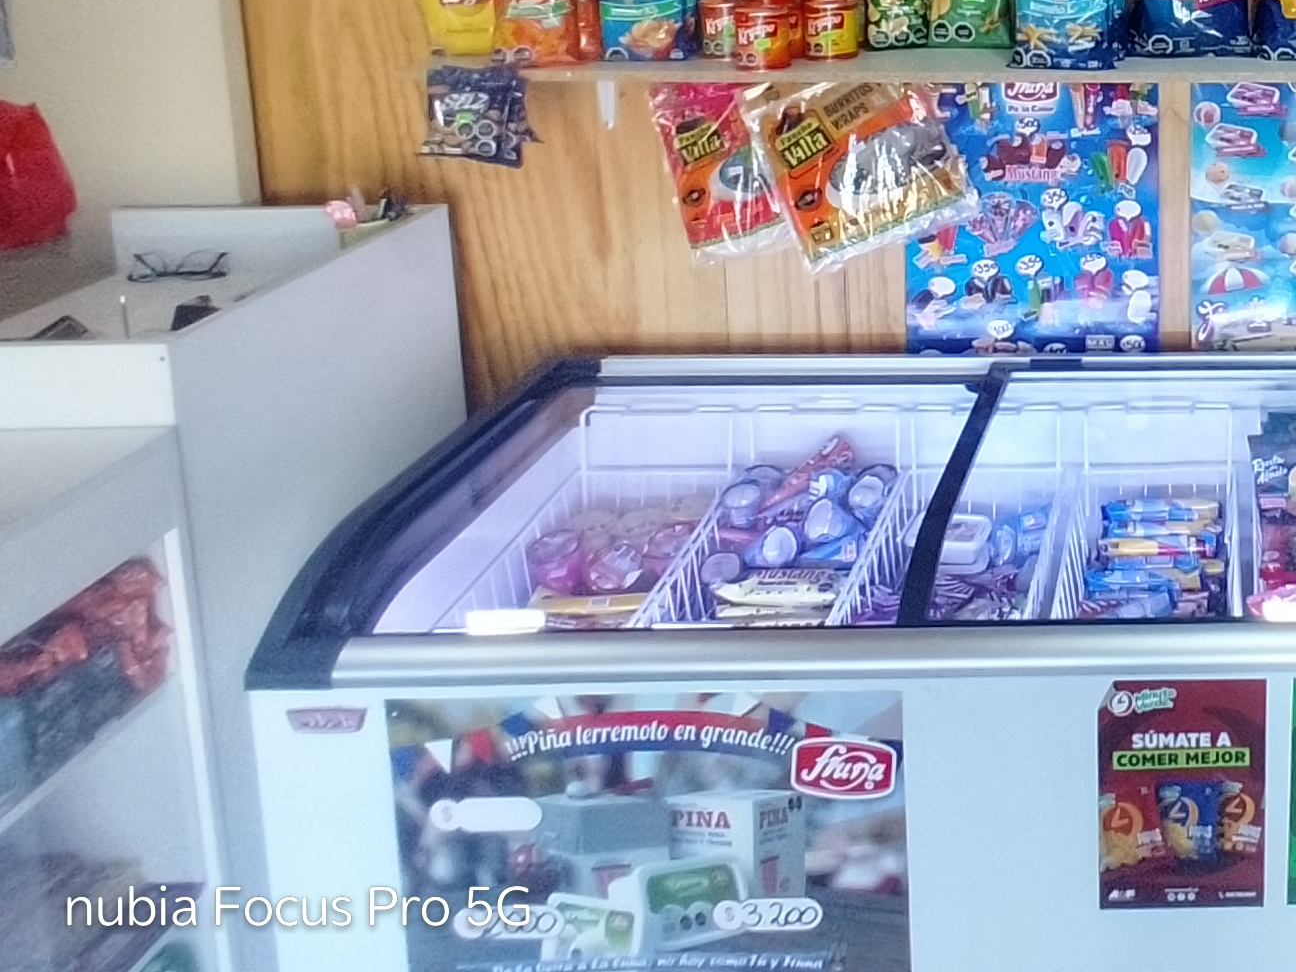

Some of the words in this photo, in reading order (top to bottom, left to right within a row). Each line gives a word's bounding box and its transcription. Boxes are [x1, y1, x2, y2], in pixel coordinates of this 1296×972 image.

[783, 131, 829, 168] Villa
[673, 724, 698, 743] en
[1131, 729, 1212, 749] SÚMATE
[1216, 731, 1232, 748] A
[1116, 753, 1179, 768] COMER
[1185, 750, 1247, 766] MEJOR
